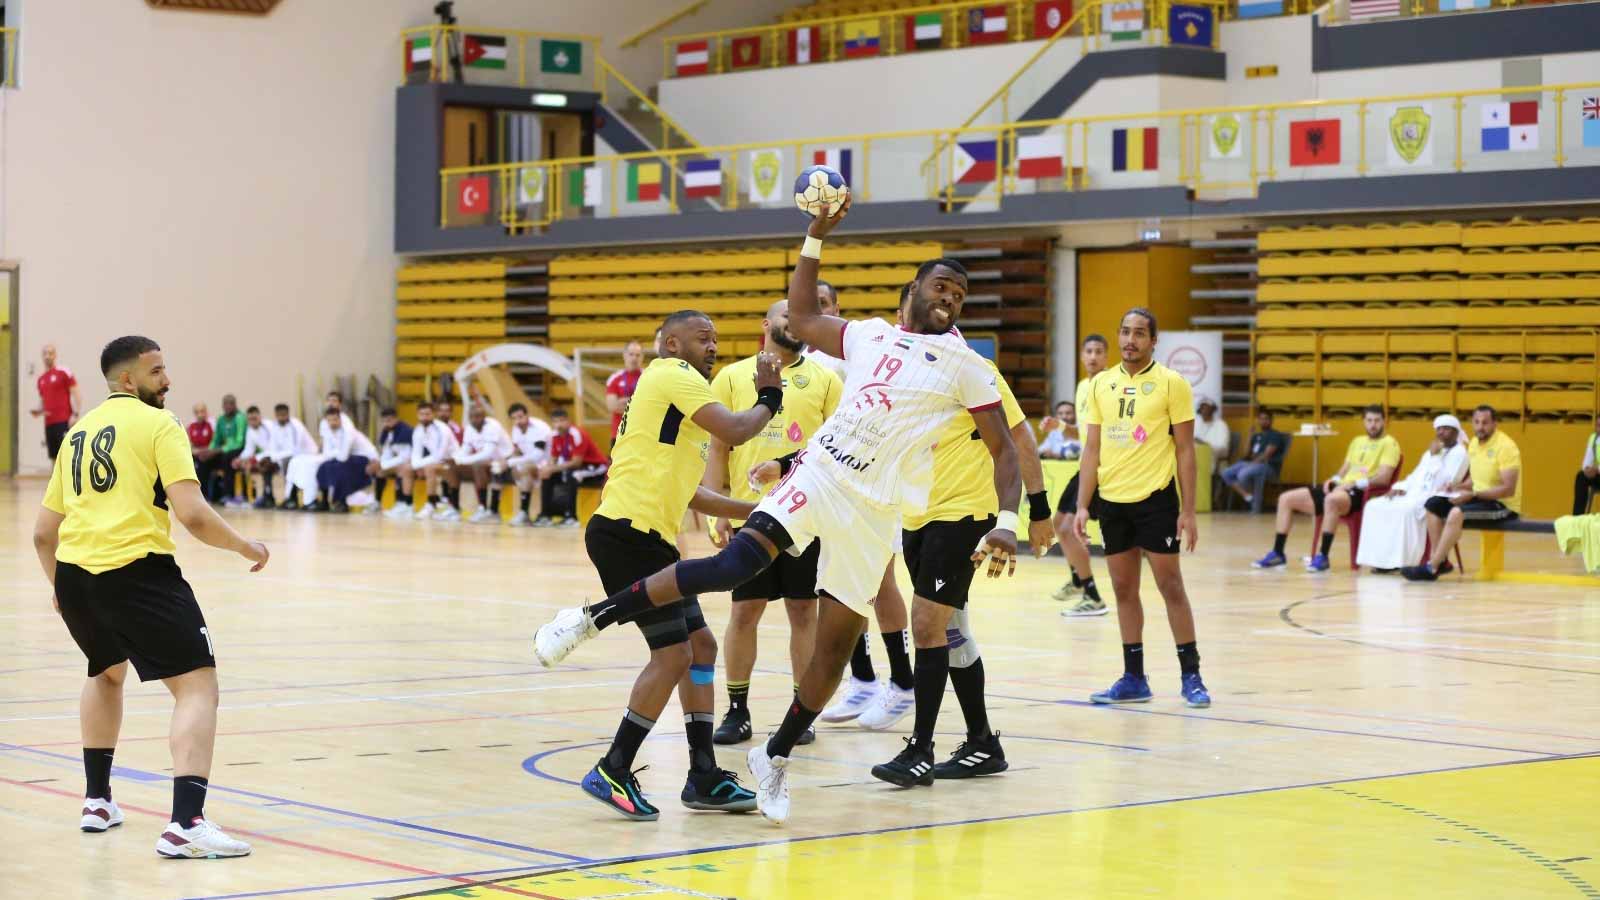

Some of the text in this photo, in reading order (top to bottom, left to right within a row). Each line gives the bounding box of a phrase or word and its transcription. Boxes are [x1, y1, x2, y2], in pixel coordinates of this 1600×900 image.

[873, 354, 903, 381] 19
[1118, 398, 1136, 419] 14
[70, 424, 118, 496] 18
[777, 485, 808, 513] 19
